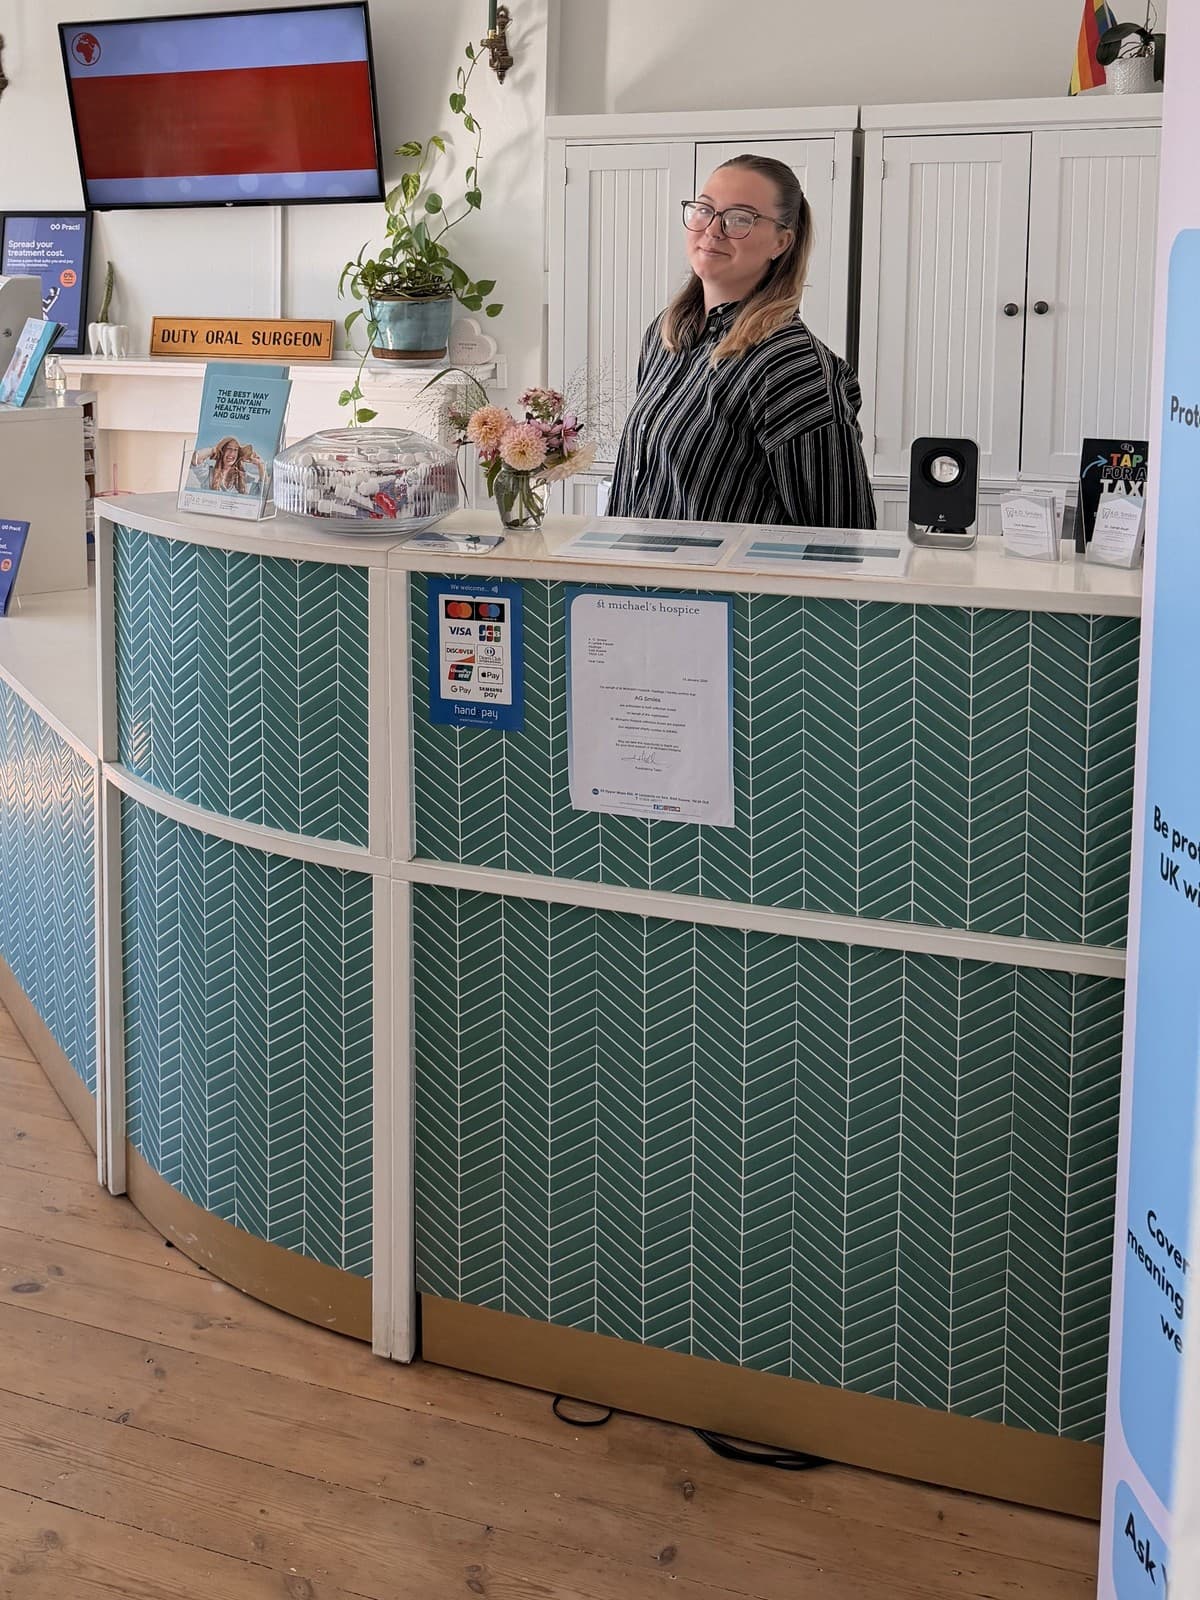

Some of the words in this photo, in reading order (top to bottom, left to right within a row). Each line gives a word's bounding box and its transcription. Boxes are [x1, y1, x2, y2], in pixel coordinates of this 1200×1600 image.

[8, 240, 35, 249] Spread
[36, 242, 54, 250] your
[7, 249, 45, 257] treatment
[161, 328, 199, 343] DUTY
[205, 330, 243, 345] ORAL
[251, 331, 323, 347] SURGEON
[218, 389, 231, 397] THE
[232, 390, 251, 398] BEST
[252, 392, 270, 400] WAY
[216, 396, 226, 404] TO
[227, 398, 262, 406] MAINTAIN
[214, 404, 247, 413] HEALTHY
[248, 407, 271, 415] TEETH
[213, 411, 228, 419] AND
[229, 413, 251, 421] GUMS
[1110, 453, 1143, 467] TAP
[1102, 465, 1133, 480] FOR
[1135, 467, 1147, 481] A
[596, 600, 606, 609] st
[608, 600, 657, 612] michael's
[659, 604, 700, 616] hospice
[448, 626, 472, 636] VISA
[446, 647, 474, 655] DISCOVER
[486, 671, 500, 681] Pay
[459, 686, 472, 696] Pay
[454, 704, 476, 716] hand
[481, 708, 498, 720] pay
[1153, 805, 1169, 838] Be
[1160, 852, 1180, 892] UK
[1124, 1512, 1157, 1586] Ask
